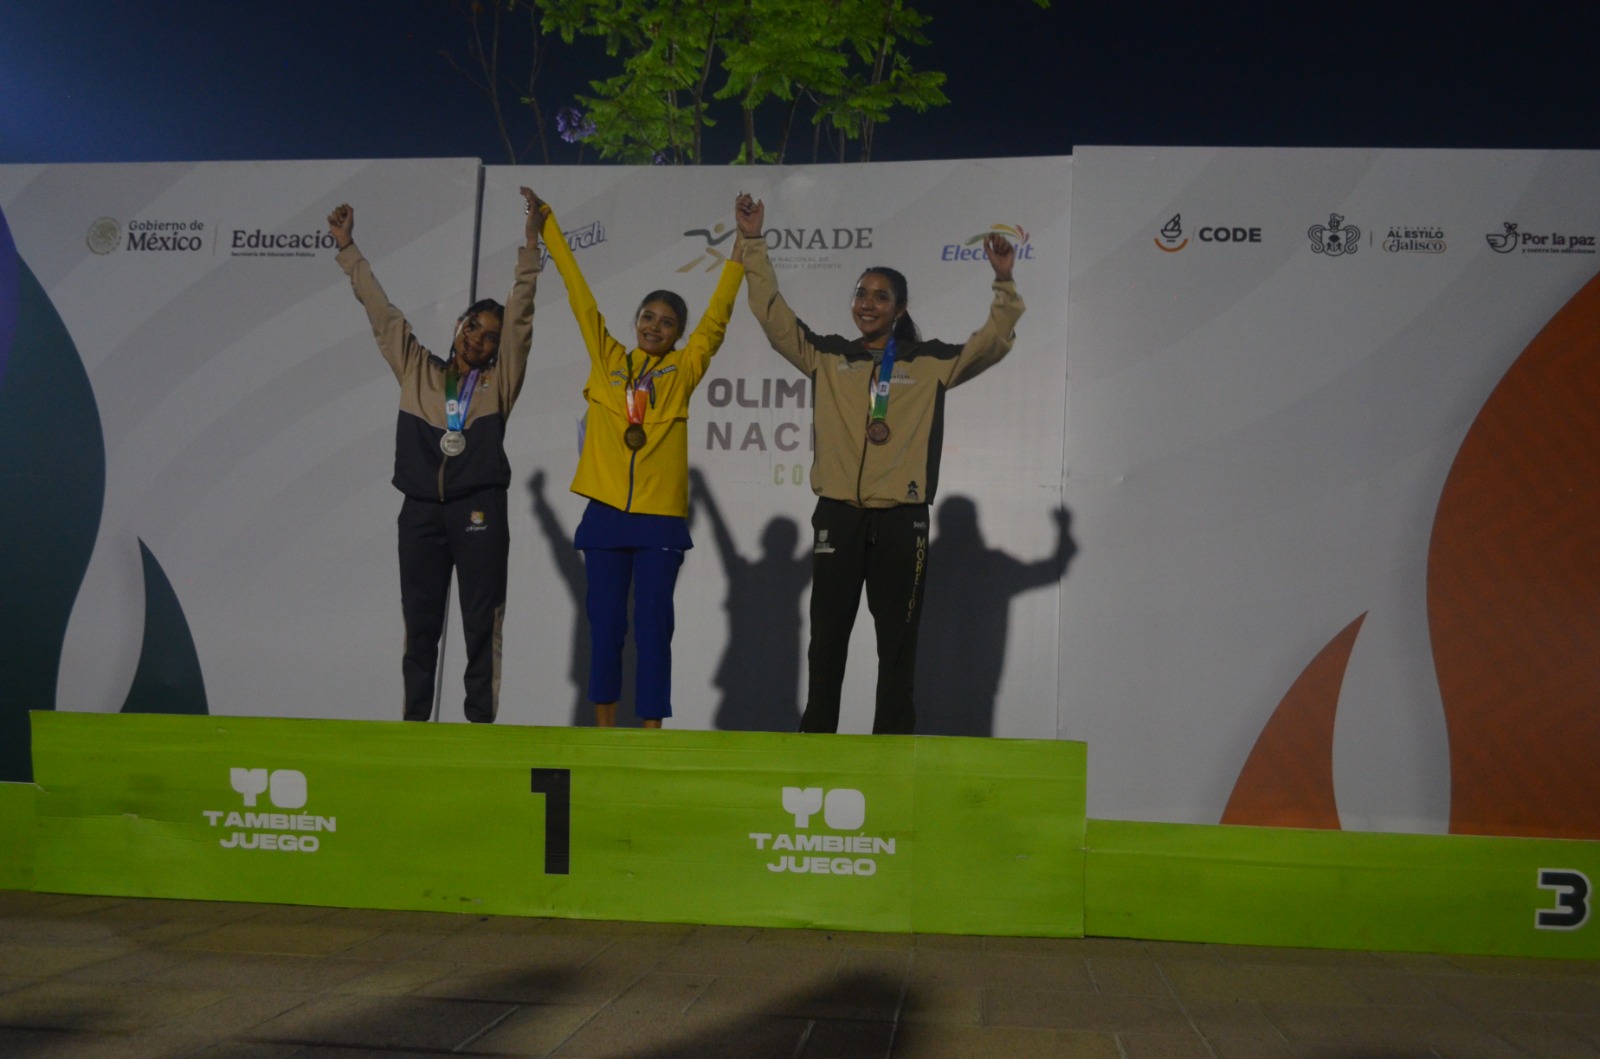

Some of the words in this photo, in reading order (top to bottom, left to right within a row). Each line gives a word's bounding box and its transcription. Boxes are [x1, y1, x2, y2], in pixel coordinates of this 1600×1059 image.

[128, 220, 187, 231] Gobierno
[189, 219, 205, 231] de
[1199, 227, 1262, 243] CODE
[1387, 230, 1402, 239] AL
[1404, 230, 1444, 239] ESTILO
[126, 232, 203, 252] México
[231, 229, 341, 249] Educació
[763, 228, 873, 250] ONADE
[1389, 239, 1443, 253] Jalisco
[1521, 232, 1549, 245] Por
[1552, 232, 1565, 245] la
[1569, 235, 1596, 248] paz
[707, 378, 814, 408] OLIM
[773, 463, 804, 486] CO
[229, 766, 308, 809] YO
[781, 786, 866, 830] YO
[202, 810, 337, 833] TAMBIÉN
[530, 768, 571, 875] 1
[219, 831, 320, 853] JUEGO
[748, 831, 896, 855] TAMBIÉN
[767, 855, 877, 877] JUEGO
[1534, 868, 1592, 930] 3
